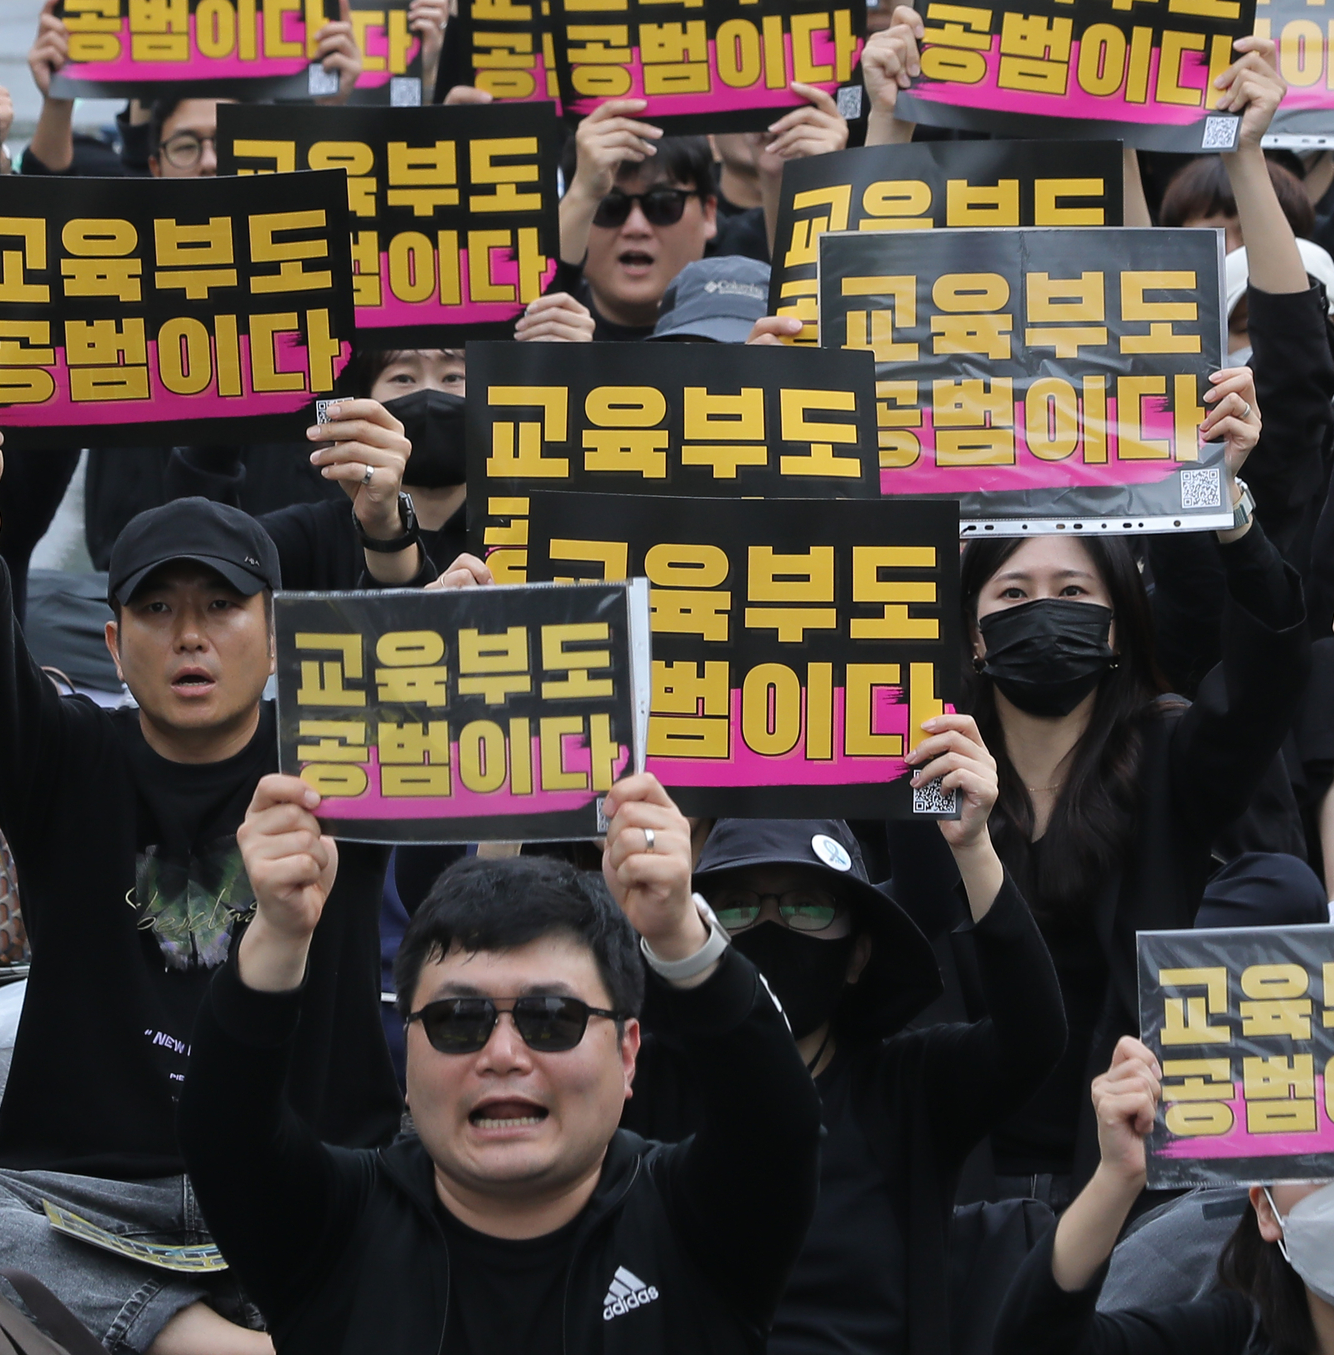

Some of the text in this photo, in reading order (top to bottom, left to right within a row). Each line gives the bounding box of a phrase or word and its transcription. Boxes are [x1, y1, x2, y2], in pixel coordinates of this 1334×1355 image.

[565, 9, 859, 96] 공범이다
[919, 3, 1235, 112] 공범이다
[840, 269, 1203, 364] 교육부도
[485, 385, 863, 480] 교육부도
[295, 622, 615, 710] 교육부도
[296, 713, 622, 799] 공범이다
[603, 1285, 659, 1321] adidas
